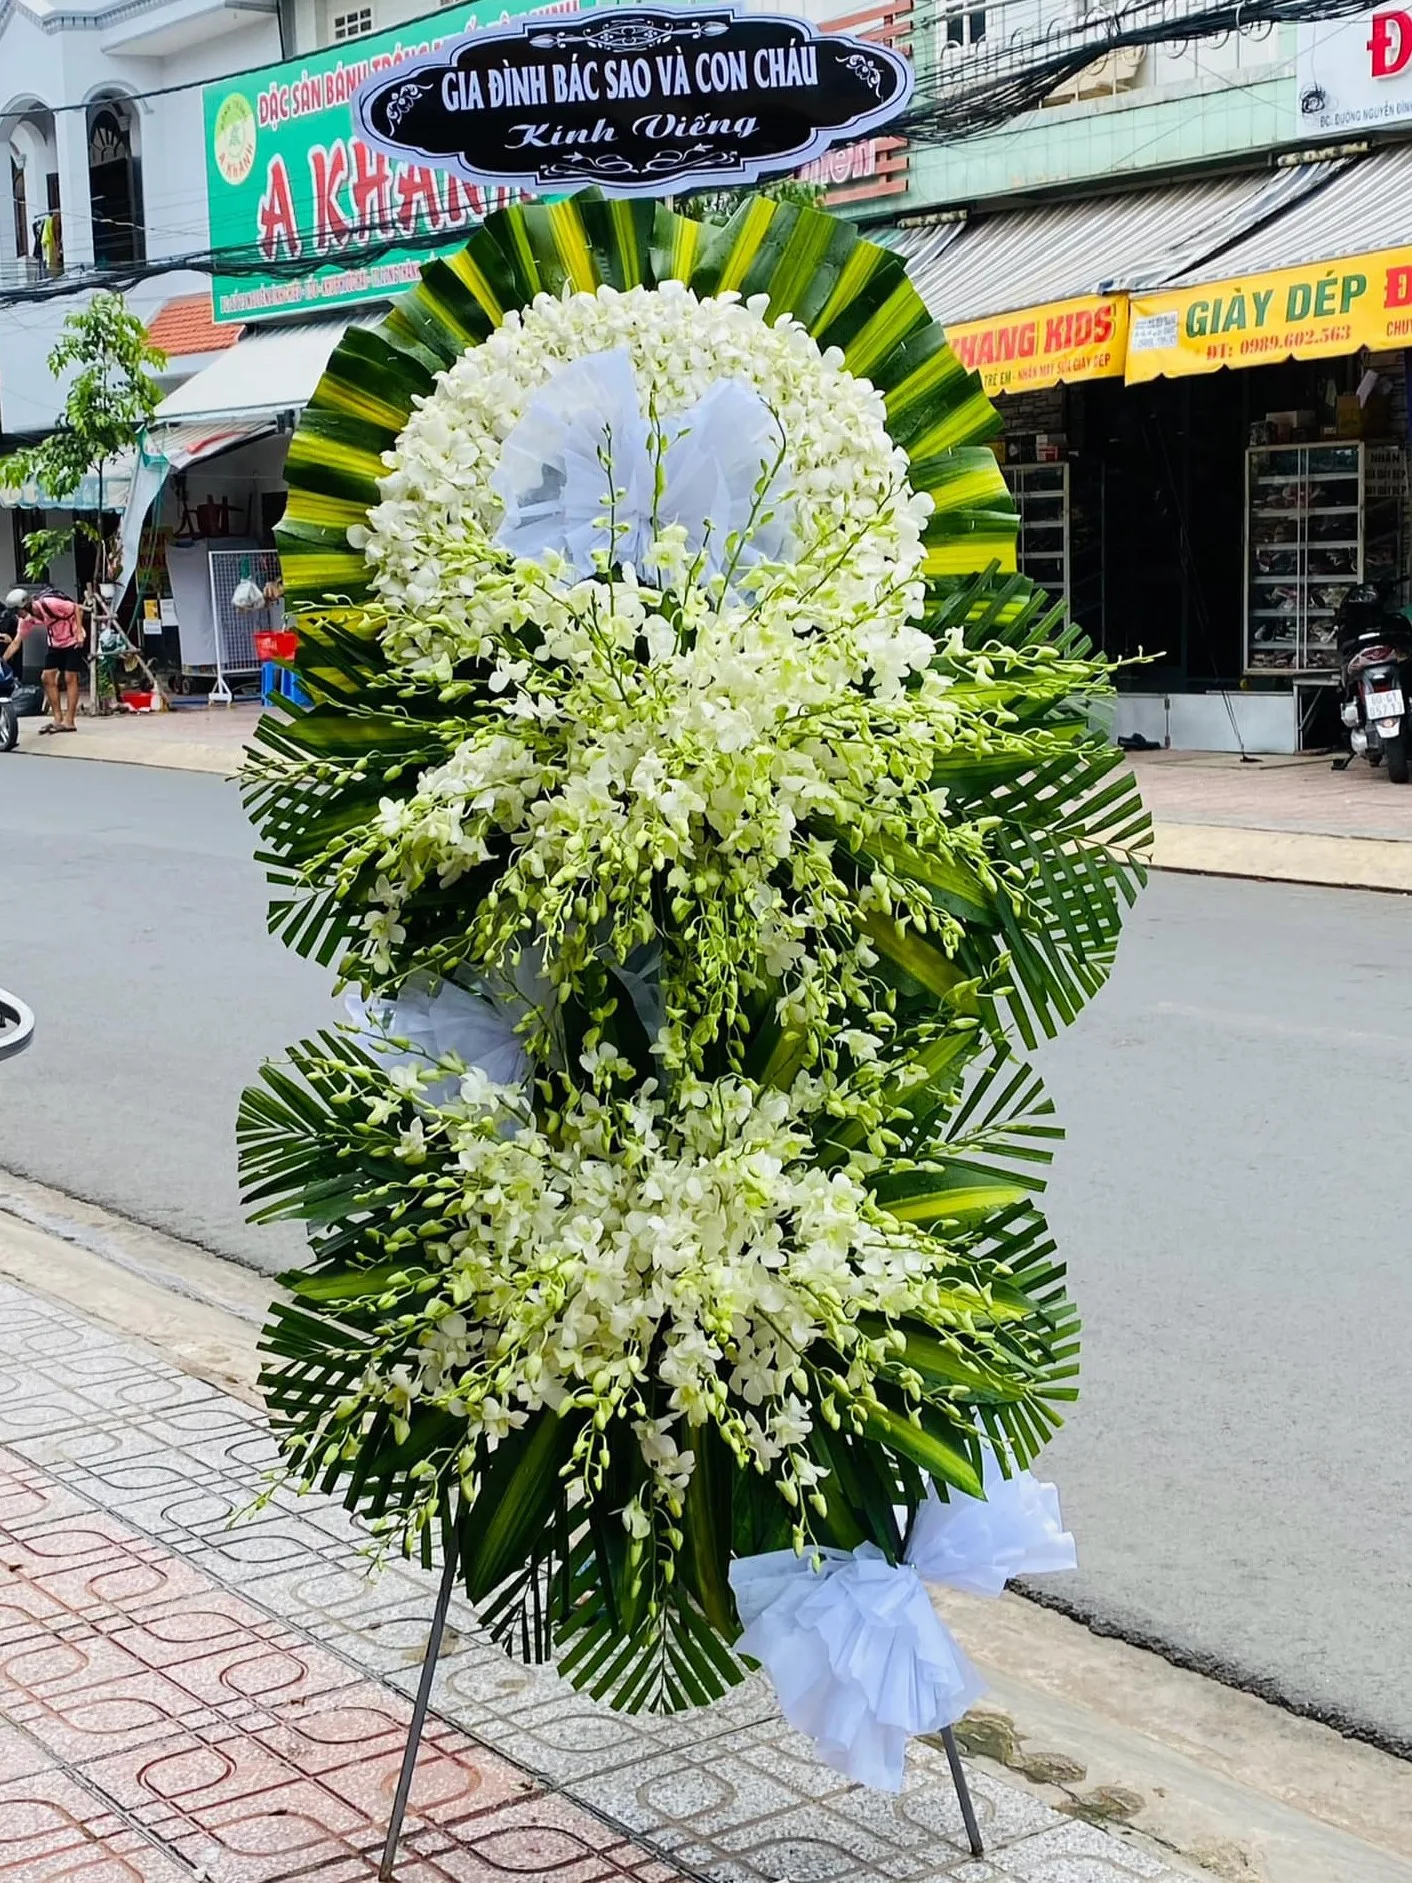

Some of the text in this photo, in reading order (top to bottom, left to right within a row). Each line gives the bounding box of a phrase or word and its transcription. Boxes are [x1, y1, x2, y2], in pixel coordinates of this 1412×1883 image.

[441, 38, 818, 112] GIA ĐÌNH BÁC SAO VÀ CON CHÁU
[504, 112, 760, 149] Kính Viếng
[259, 140, 532, 259] A KHAN
[949, 322, 1036, 369] HANG
[1044, 305, 1114, 353] KIDS
[1186, 286, 1274, 338] GIÀY
[1285, 270, 1367, 323] DÉP
[1386, 319, 1412, 337] CHU
